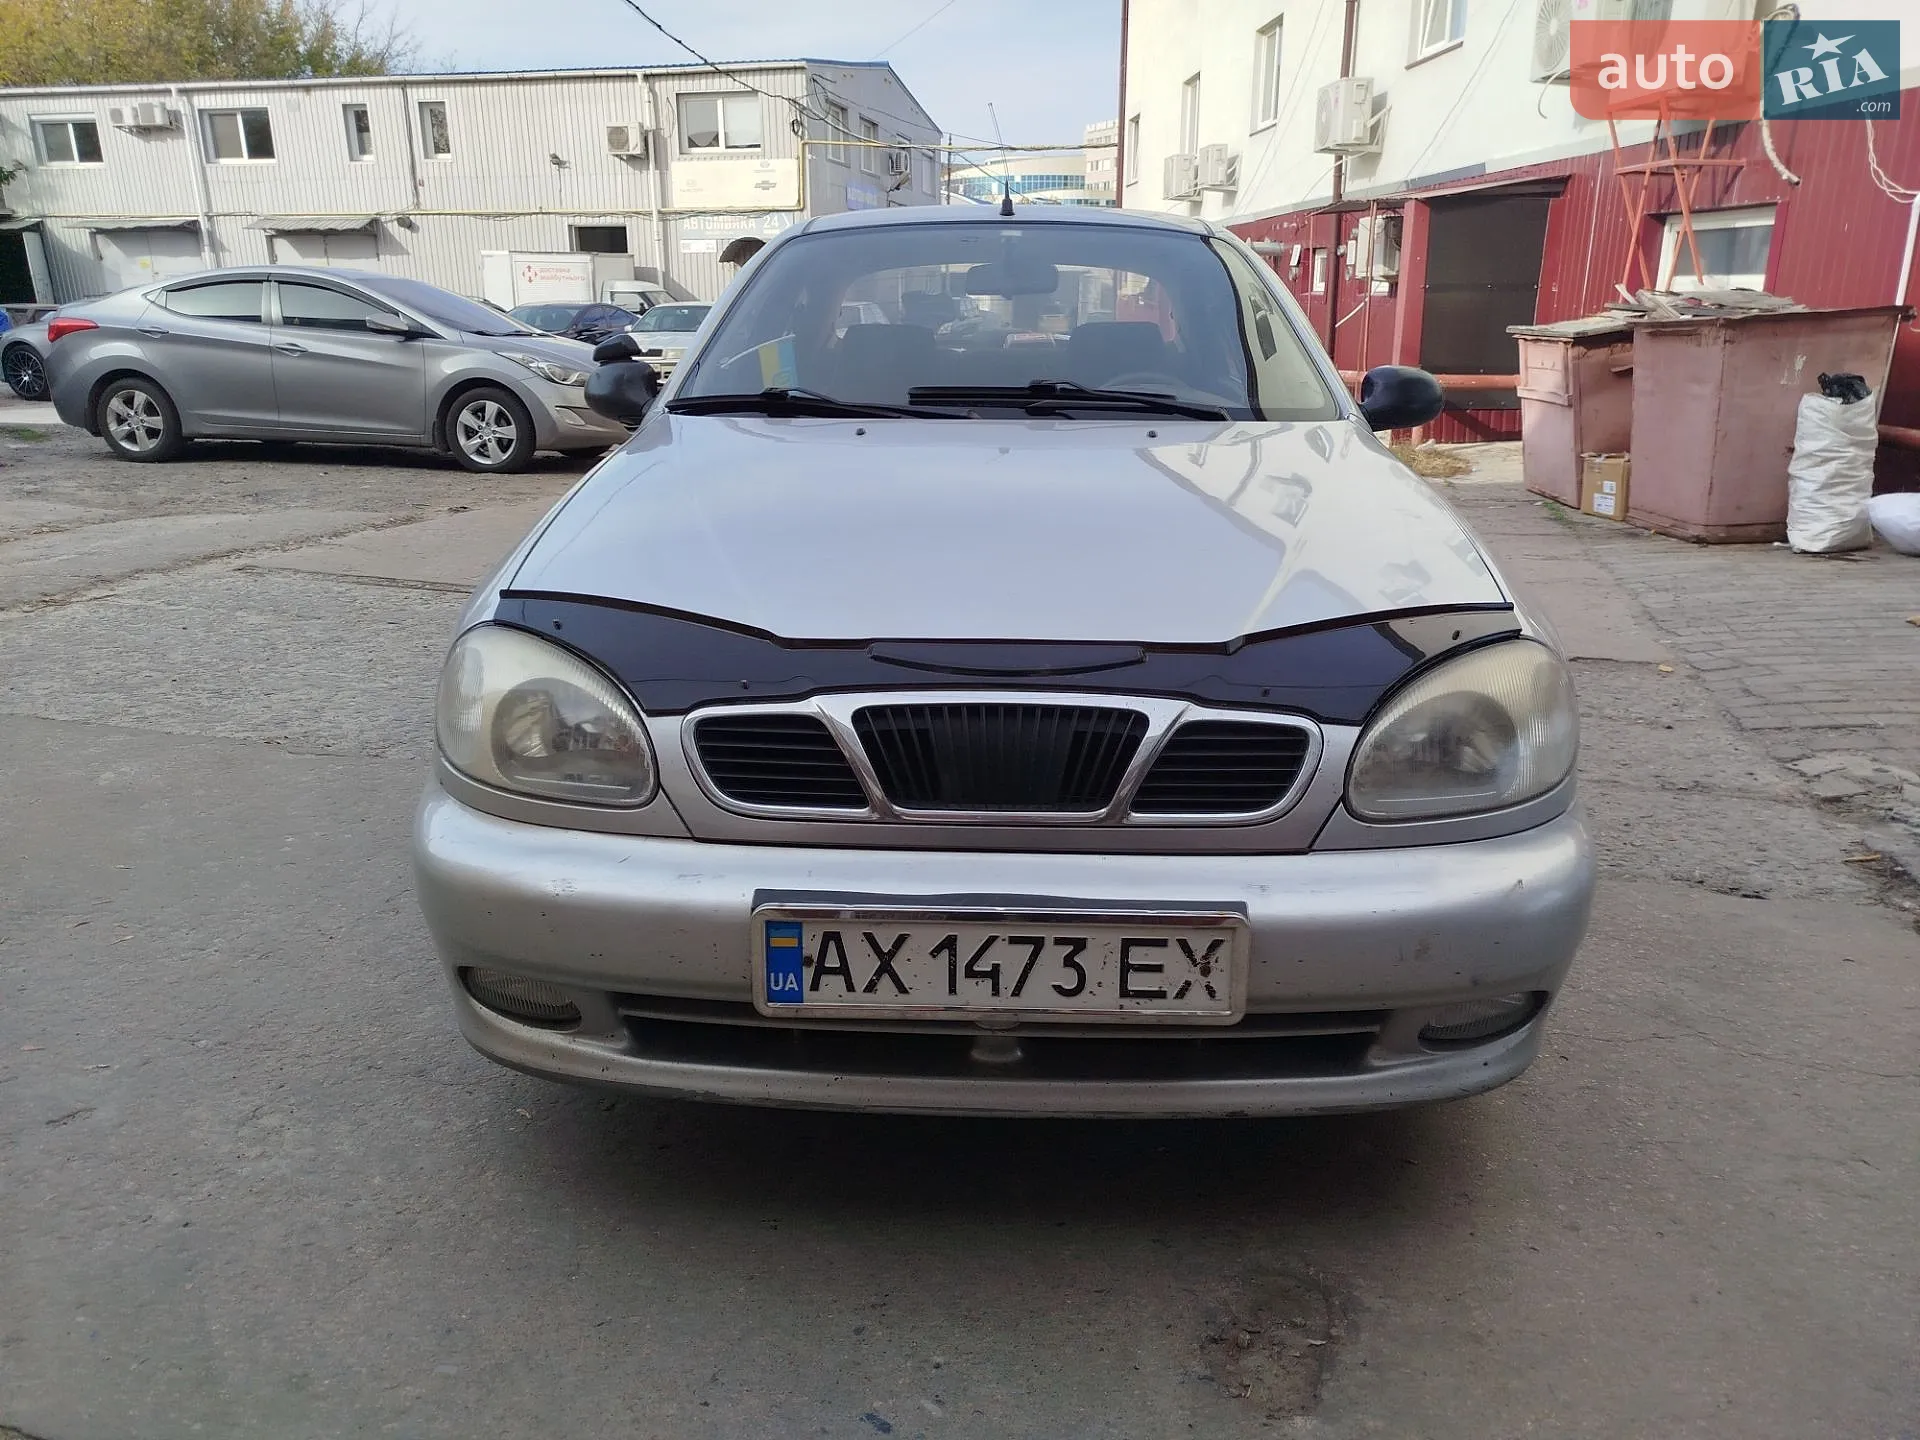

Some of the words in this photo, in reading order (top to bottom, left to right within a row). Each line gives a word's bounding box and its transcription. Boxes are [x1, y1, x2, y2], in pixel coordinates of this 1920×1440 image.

[763, 215, 779, 228] 24
[809, 930, 911, 995] AX
[928, 934, 1088, 998] 1473
[1119, 937, 1225, 1000] EX
[769, 972, 799, 992] UA
